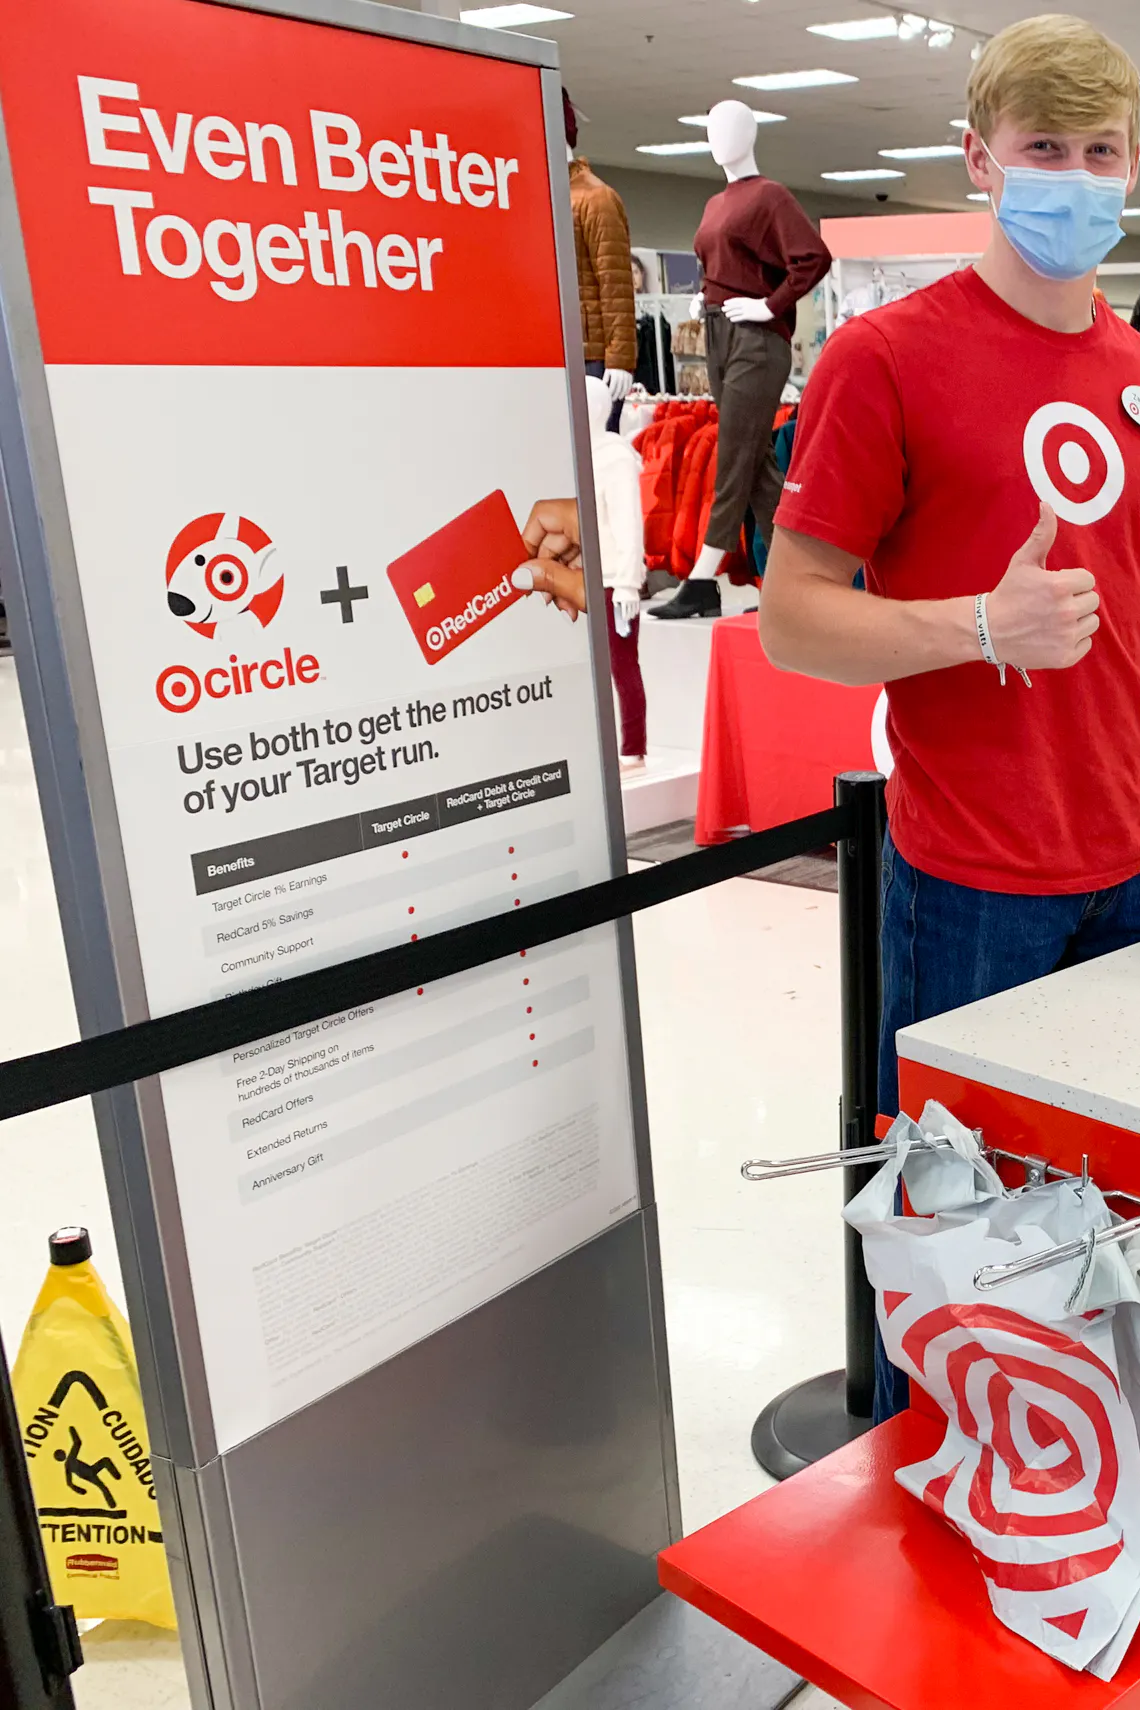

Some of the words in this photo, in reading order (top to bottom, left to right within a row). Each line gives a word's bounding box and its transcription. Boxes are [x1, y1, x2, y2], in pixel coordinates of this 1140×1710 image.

[77, 75, 298, 187] Even
[309, 109, 518, 210] Better
[87, 186, 443, 302] Together
[440, 575, 513, 641] RedCard
[204, 647, 321, 699] circle
[177, 742, 244, 775] Use
[249, 722, 320, 762] both
[323, 719, 353, 746] to
[358, 706, 403, 746] get
[405, 700, 447, 728] the
[453, 683, 513, 719] most
[516, 675, 553, 705] out
[183, 779, 216, 815] of
[221, 771, 292, 814] your
[296, 746, 388, 787] Target
[392, 740, 440, 769] run.
[446, 788, 485, 809] RedCard
[484, 783, 507, 798] Debit
[508, 781, 516, 792] &
[516, 775, 542, 790] Credit
[542, 769, 562, 783] Card
[484, 793, 511, 811] Target
[511, 788, 536, 802] Circle
[371, 819, 402, 834] Target
[403, 811, 430, 826] Circle
[207, 857, 256, 878] Benefits
[212, 897, 243, 913] Target
[244, 890, 271, 904] Circle
[274, 884, 287, 896] 1%
[288, 873, 329, 892] Earnings
[216, 922, 260, 944] RedCard
[262, 919, 276, 931] 5%
[279, 907, 314, 925] Savings
[221, 949, 275, 974] Community
[277, 937, 314, 957] Support
[232, 1036, 291, 1064] Personalized
[293, 1024, 320, 1042] Target
[321, 1016, 346, 1031] Circle
[347, 1006, 375, 1021] Offers
[236, 1073, 257, 1089] Free
[259, 1064, 286, 1081] 2-Day
[287, 1048, 326, 1070] Shipping
[327, 1043, 340, 1055] on
[238, 1079, 281, 1103] hundreds
[283, 1074, 294, 1085] of
[294, 1056, 340, 1081] thousands
[341, 1052, 351, 1063] of
[351, 1042, 376, 1059] items
[241, 1105, 284, 1129] RedCard
[285, 1094, 315, 1112] Offers
[246, 1135, 292, 1160] Extended
[293, 1120, 329, 1141] Returns
[252, 1162, 306, 1191] Anniversary
[307, 1153, 325, 1167] Gift
